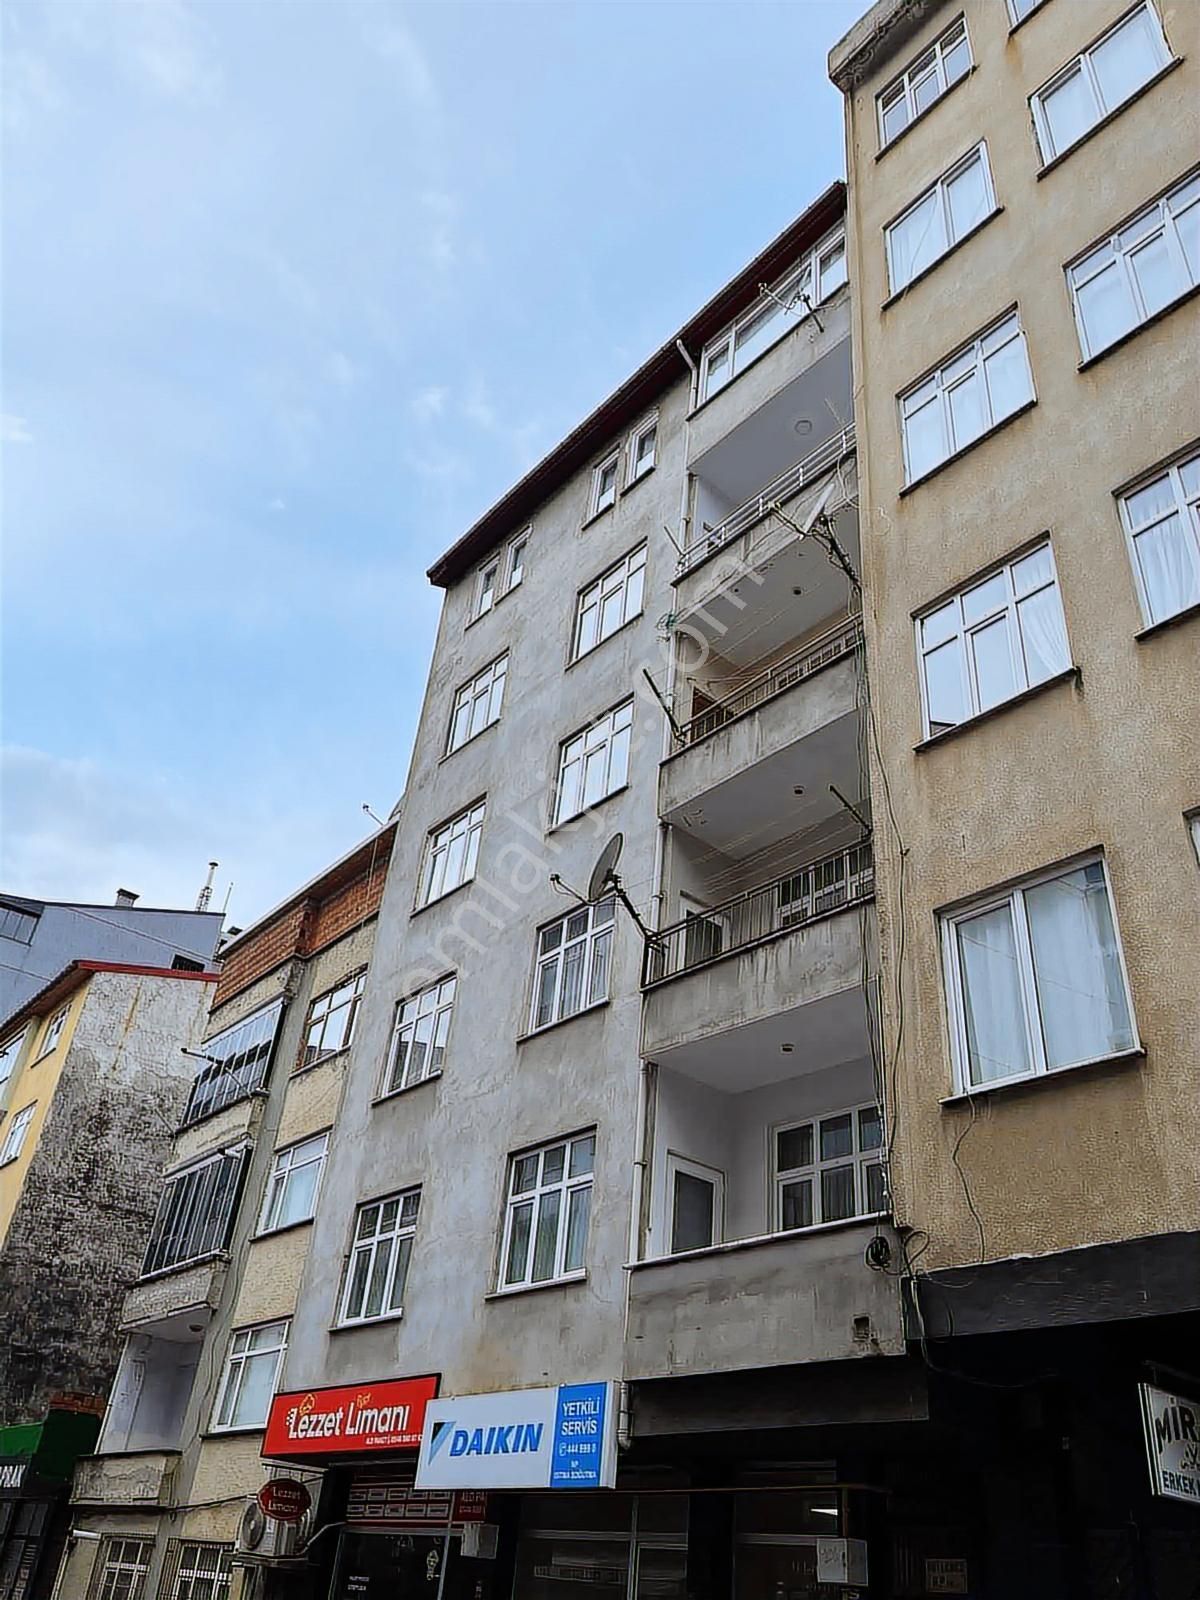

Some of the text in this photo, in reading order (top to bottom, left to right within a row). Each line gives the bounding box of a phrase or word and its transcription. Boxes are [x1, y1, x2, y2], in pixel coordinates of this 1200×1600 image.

[562, 1396, 600, 1417] YETKİLİ
[288, 1406, 344, 1439] Lezzet
[561, 1417, 597, 1436] SERVİS
[1155, 1395, 1200, 1455] MİR
[449, 1422, 543, 1456] DAIKIN
[1162, 1470, 1197, 1496] ERKEK
